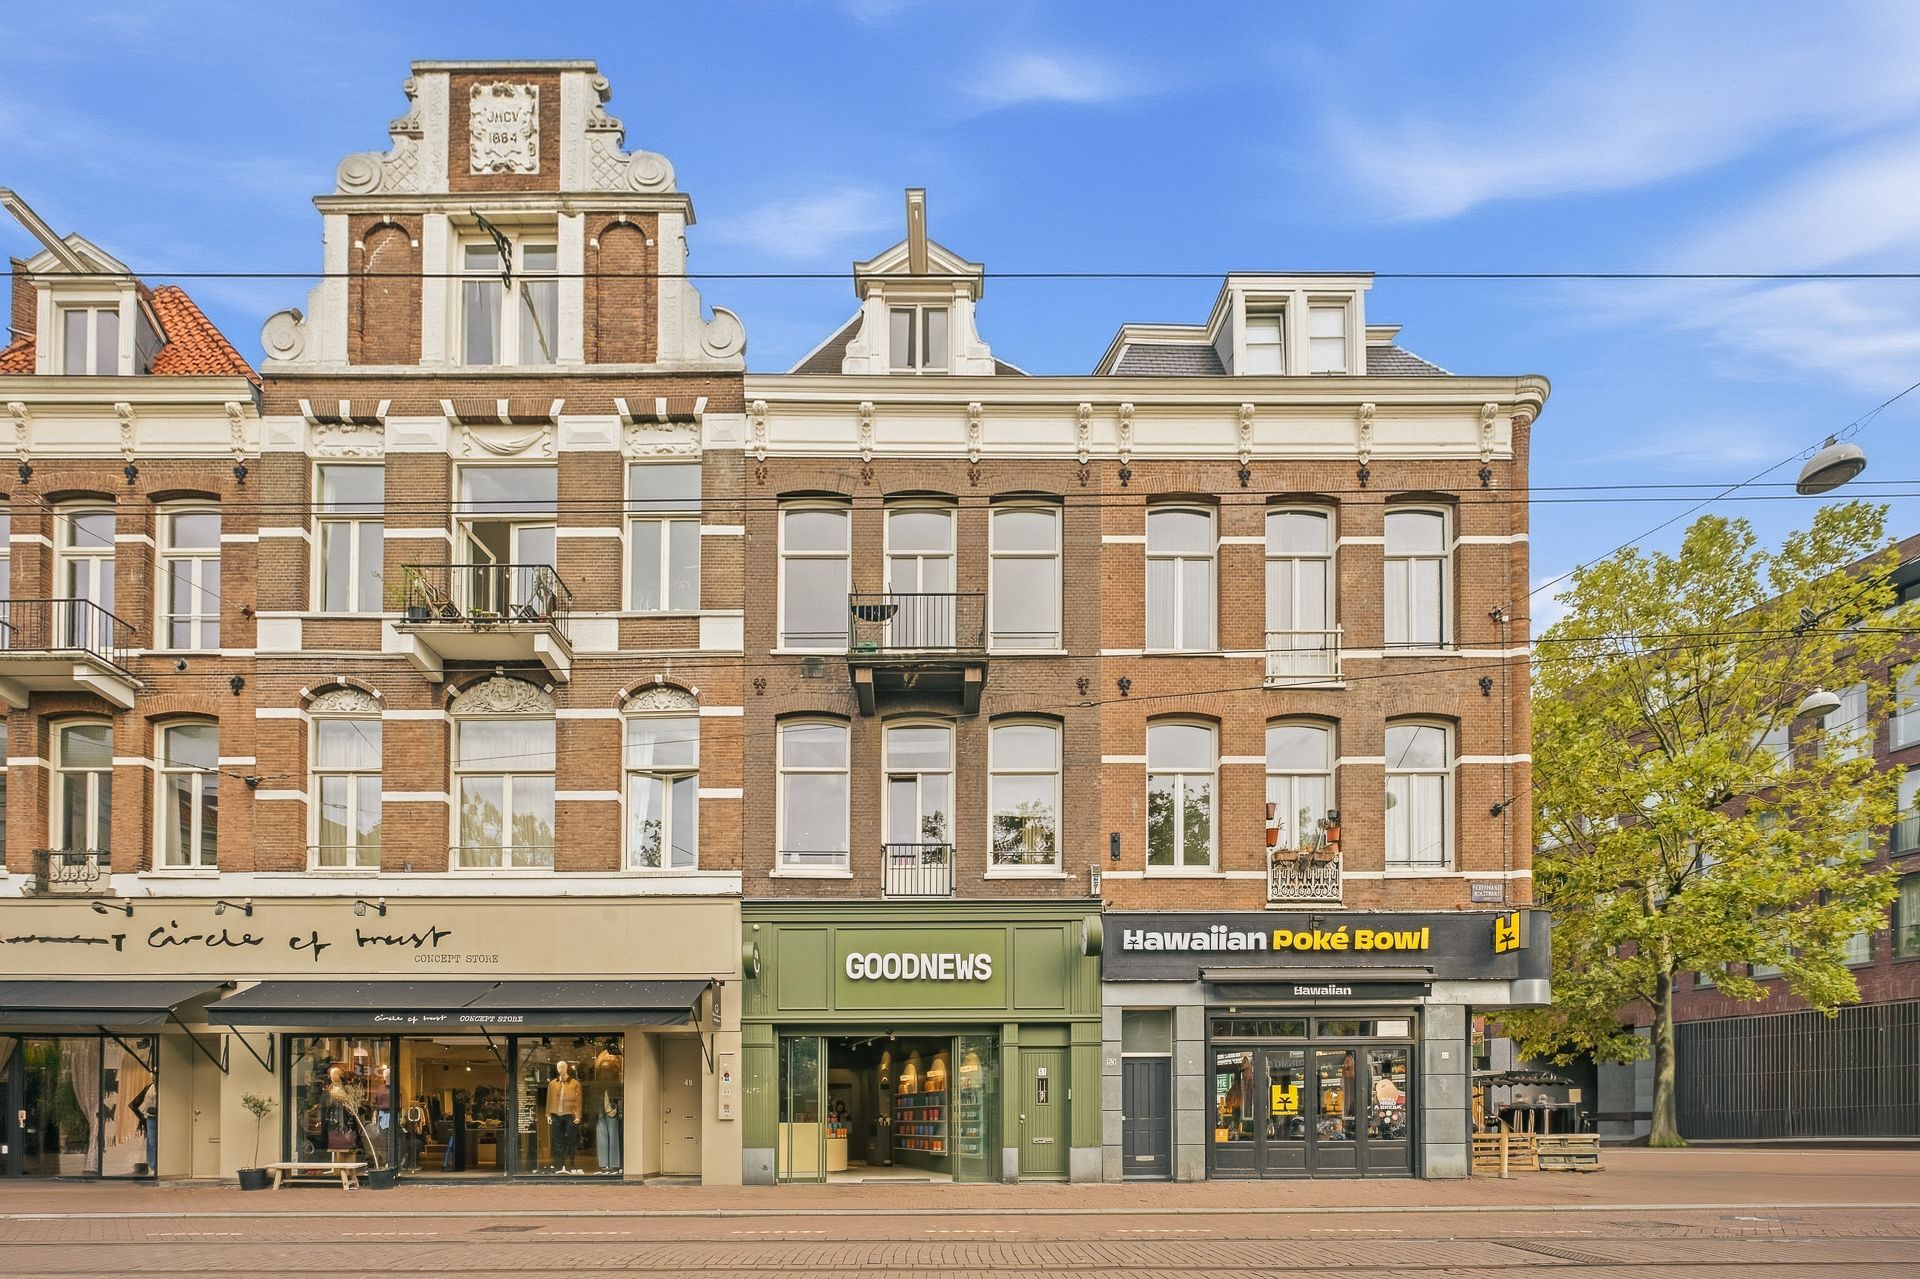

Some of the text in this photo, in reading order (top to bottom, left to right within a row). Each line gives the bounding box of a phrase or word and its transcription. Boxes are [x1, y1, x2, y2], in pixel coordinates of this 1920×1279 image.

[1123, 924, 1430, 951] Hawaiian Poké Bowl
[414, 954, 499, 964] CONCEPT STORE
[845, 952, 993, 981] GOODNEWS
[1293, 984, 1352, 996] Hawaiian
[497, 1015, 524, 1023] STORE
